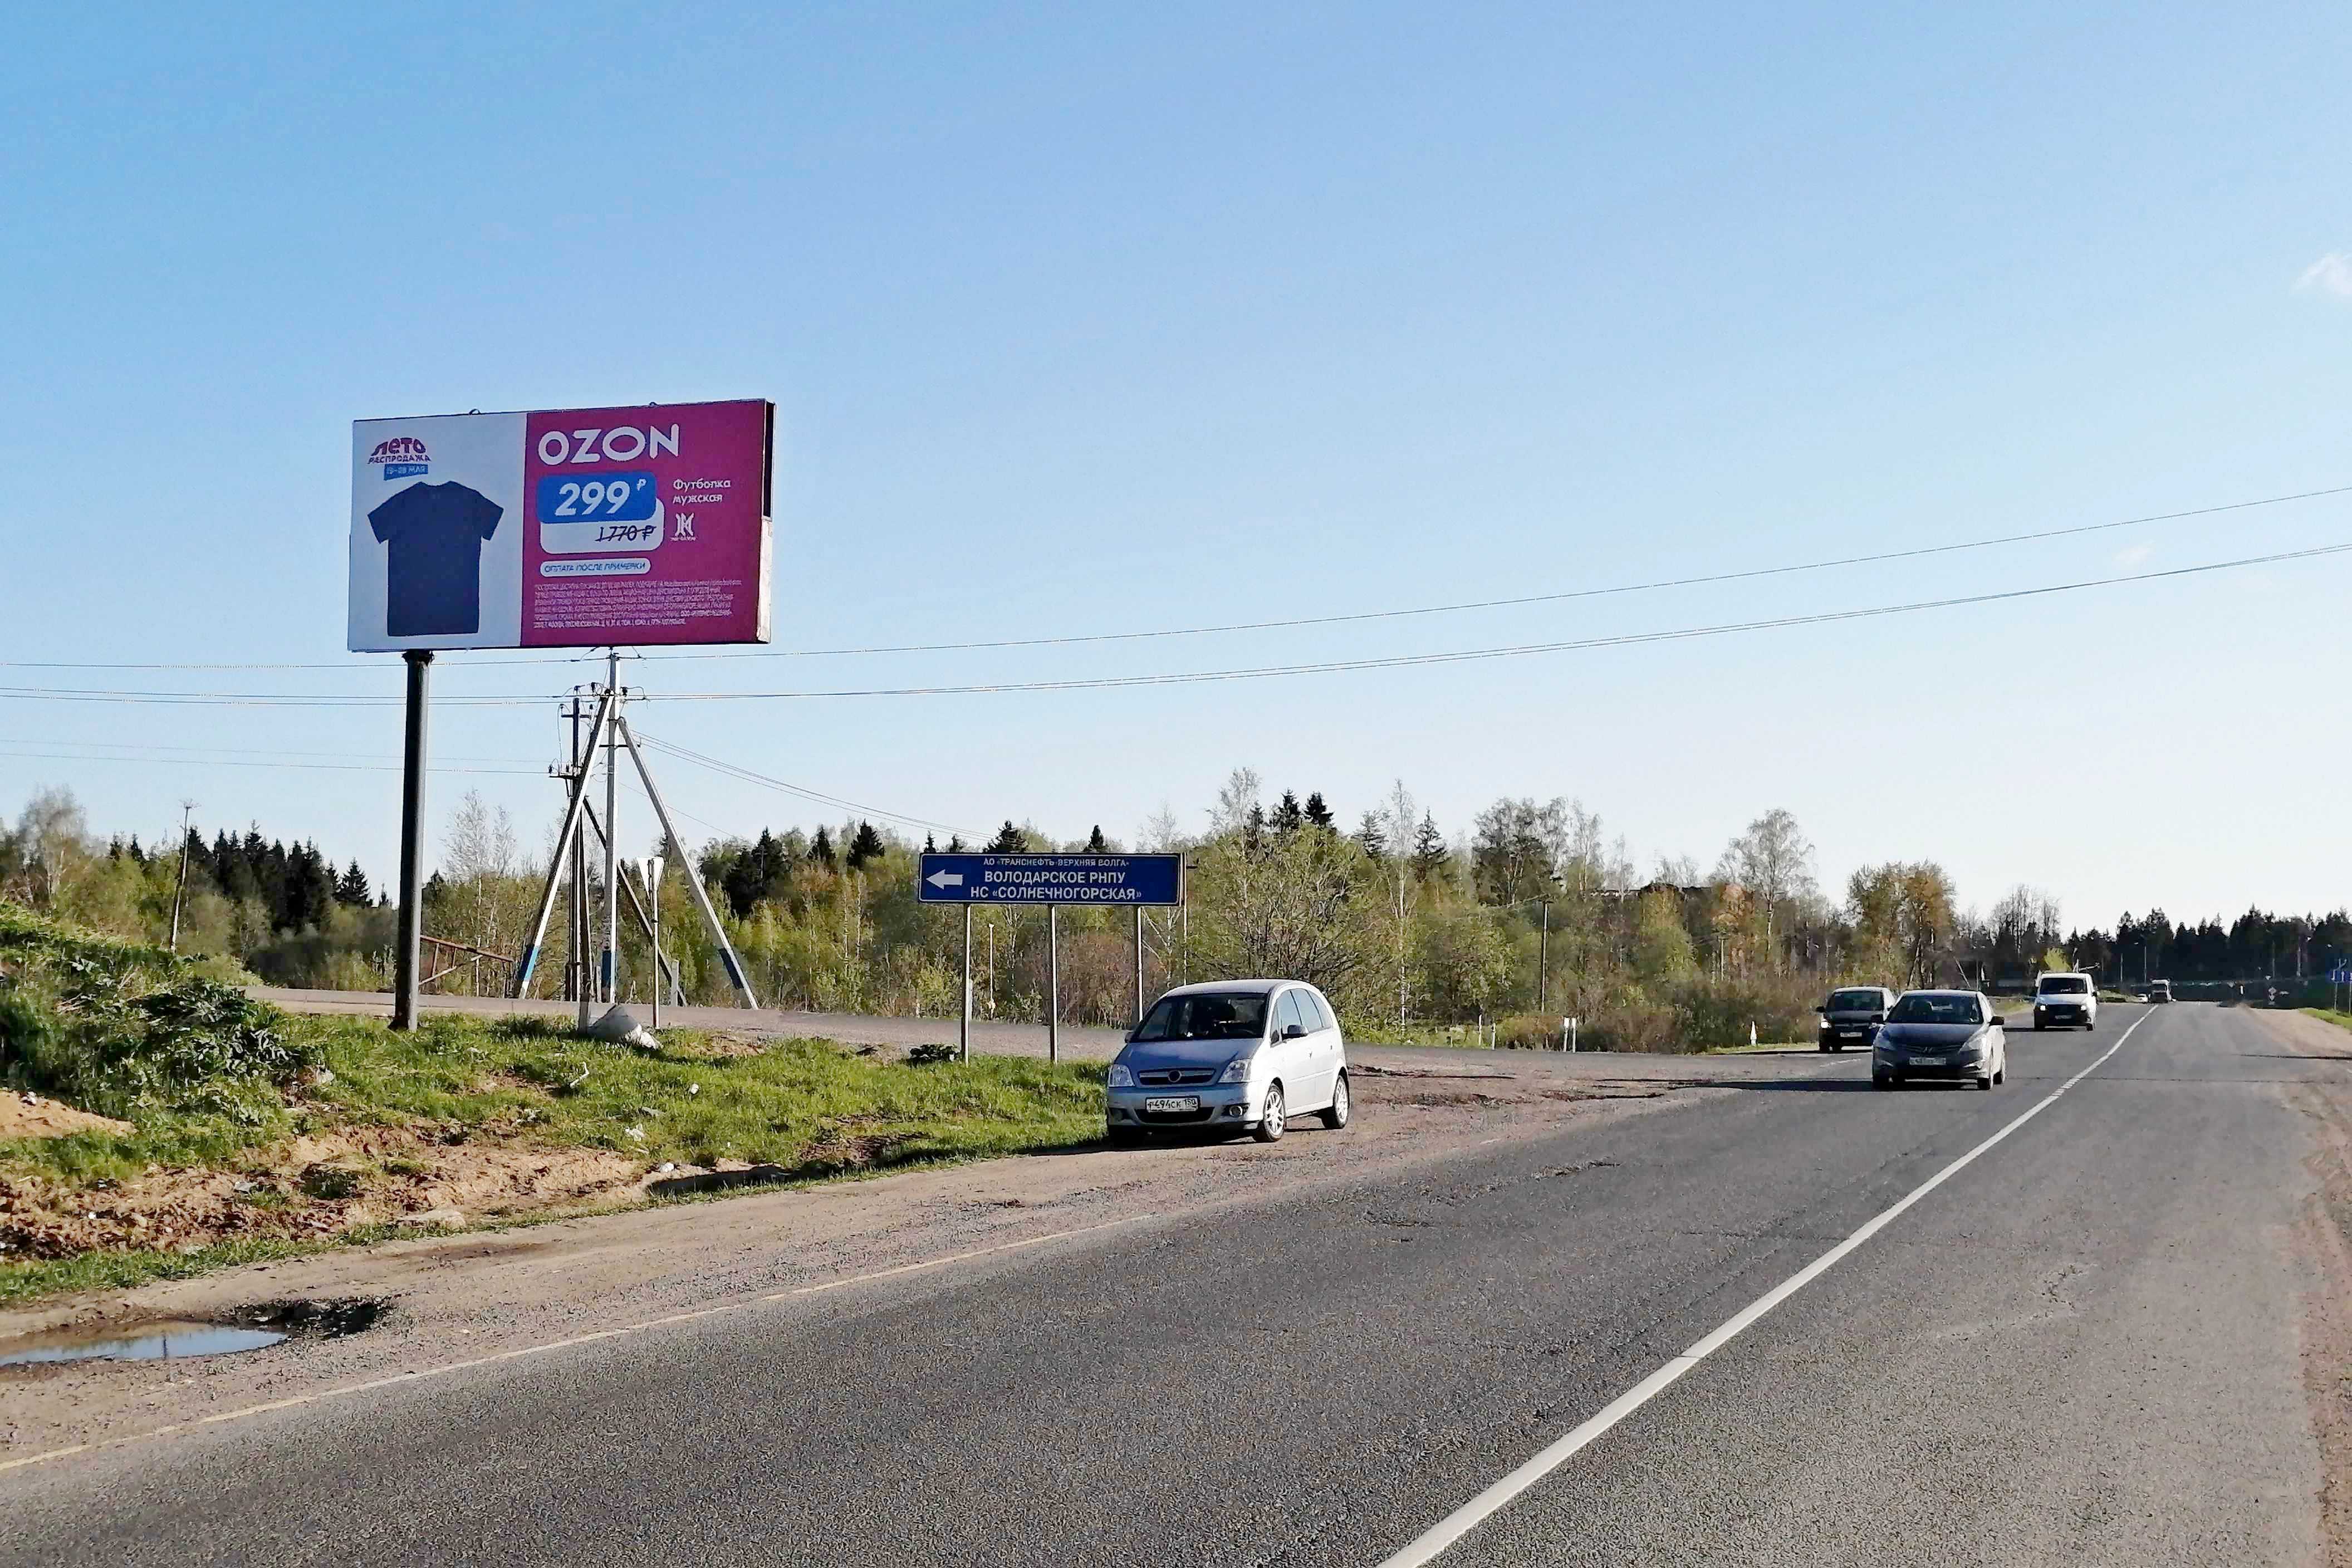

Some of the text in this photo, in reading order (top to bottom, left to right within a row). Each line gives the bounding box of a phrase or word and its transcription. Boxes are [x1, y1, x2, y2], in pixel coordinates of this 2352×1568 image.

[538, 424, 679, 465] OZON
[673, 478, 731, 493] Футболка
[555, 481, 630, 516] 299
[672, 494, 723, 506] мужская
[576, 563, 602, 571] ПОСЛЕ
[984, 871, 1125, 885] ВОЛОДАРСКОЕ РНПУ
[971, 886, 1141, 900] НС «СОЛНЕЧНОГОРСКАЯ»
